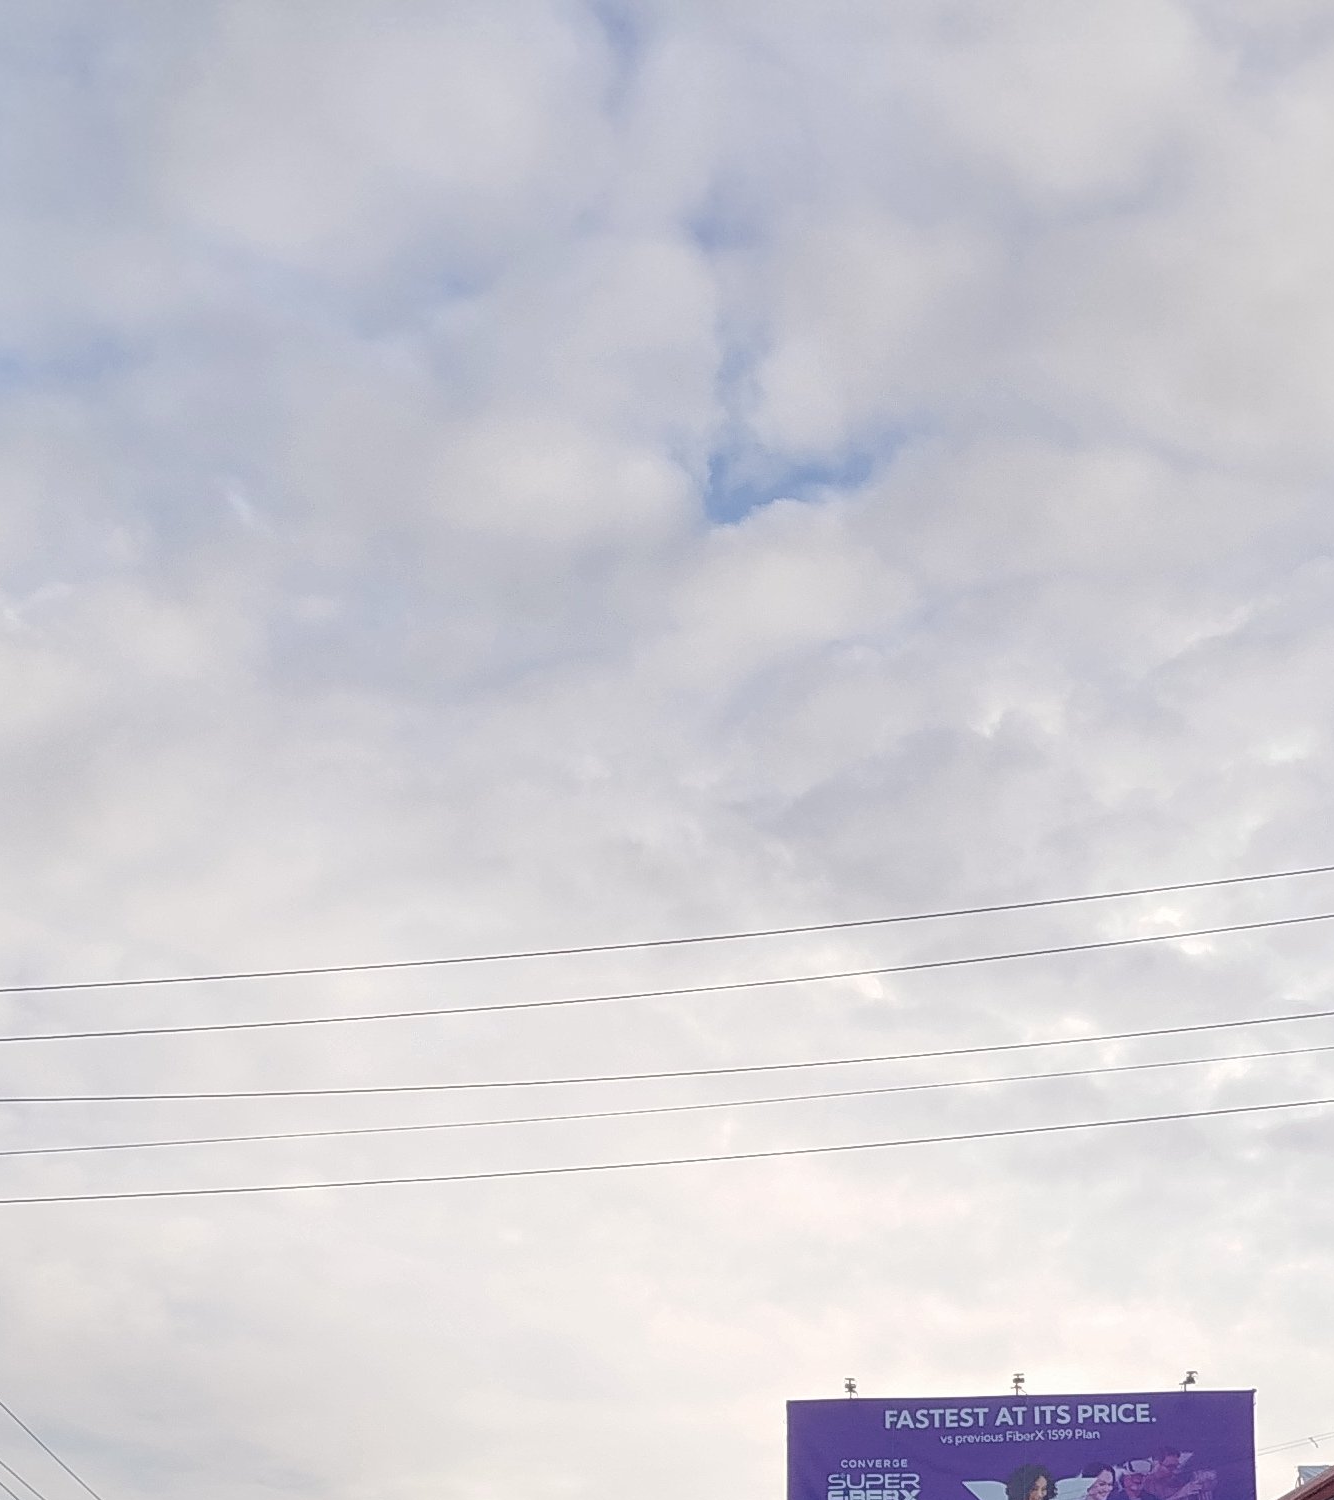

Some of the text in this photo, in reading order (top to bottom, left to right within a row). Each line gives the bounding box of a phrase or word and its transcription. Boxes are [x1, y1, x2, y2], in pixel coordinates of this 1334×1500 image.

[884, 1403, 1156, 1429] FASTEST AT ITS PRICE.
[940, 1429, 1100, 1446] vs previous FiberX 1599 Plan
[840, 1459, 908, 1468] CONVERGE
[827, 1473, 920, 1490] SUPER
